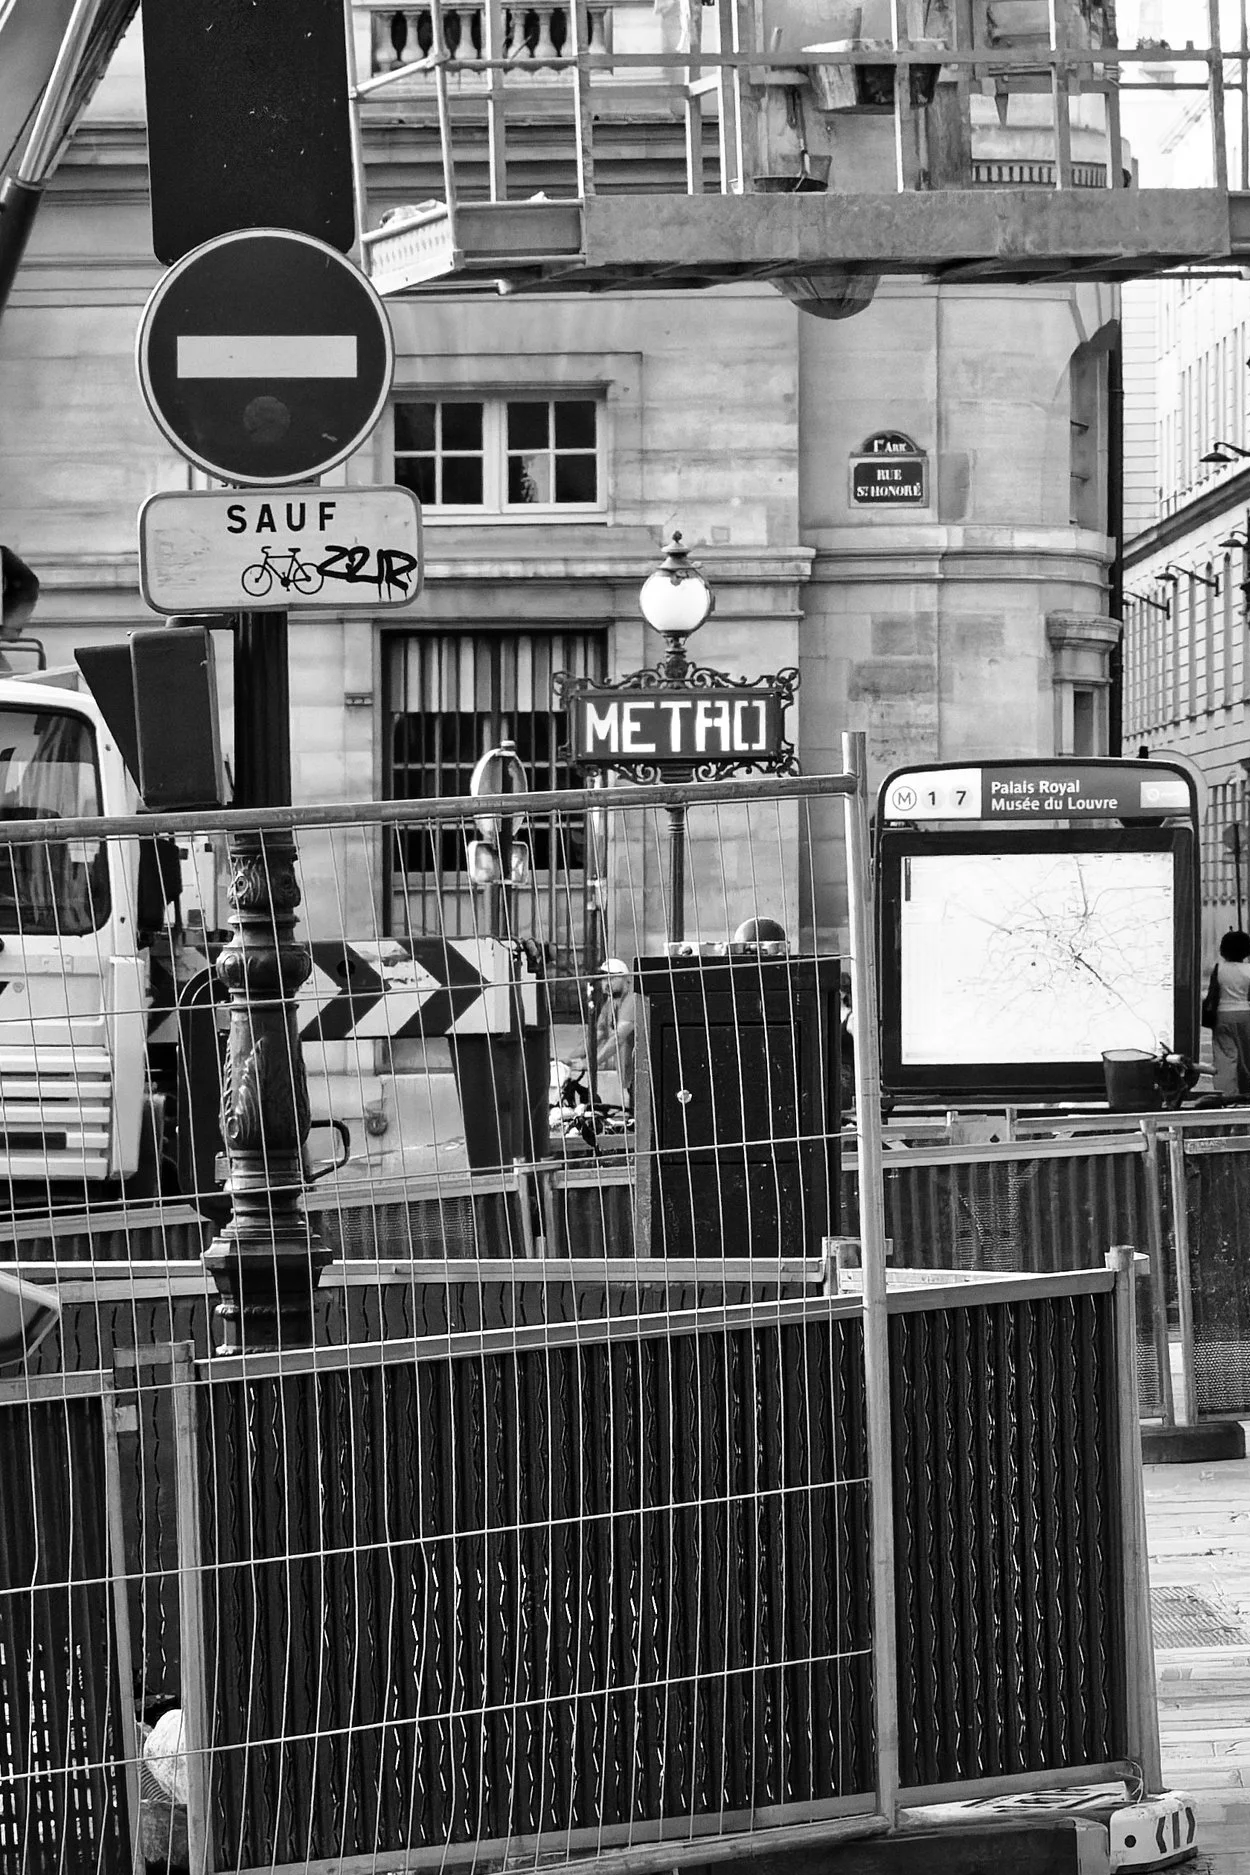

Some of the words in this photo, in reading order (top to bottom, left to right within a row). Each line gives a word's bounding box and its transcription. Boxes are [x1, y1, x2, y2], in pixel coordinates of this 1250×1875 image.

[877, 469, 902, 480] RUE
[870, 482, 921, 497] HONORÉ
[226, 501, 336, 534] SAUF
[991, 780, 1035, 794] Palais
[1039, 779, 1080, 796] Royal
[928, 791, 935, 806] 1
[956, 790, 966, 806] 7
[991, 797, 1040, 811] Musée
[1044, 796, 1063, 810] du
[1068, 797, 1118, 810] Louvre
